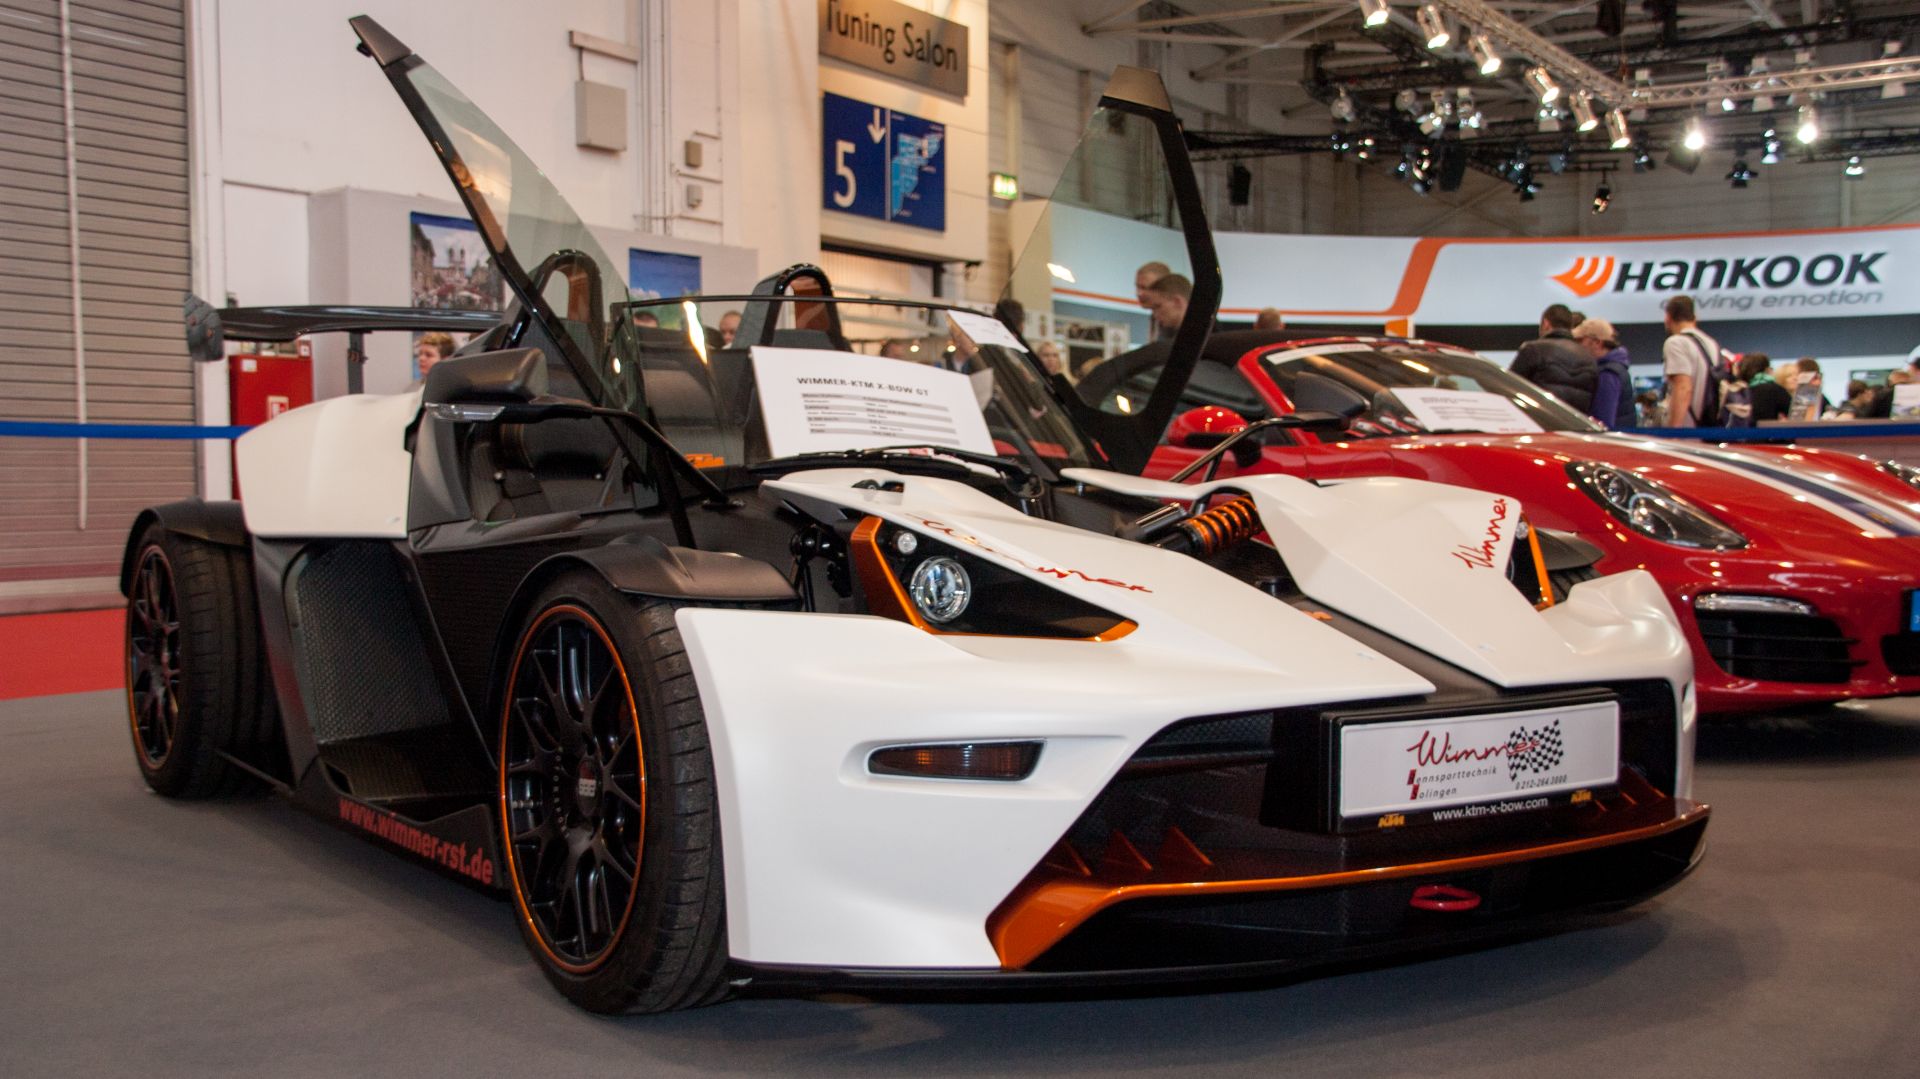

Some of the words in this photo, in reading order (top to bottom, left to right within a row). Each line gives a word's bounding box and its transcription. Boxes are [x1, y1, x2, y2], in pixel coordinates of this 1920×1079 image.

[826, 0, 897, 64] Tuning
[902, 22, 958, 72] Salon
[833, 140, 857, 208] 5
[1760, 290, 1884, 309] emotion
[1406, 730, 1540, 767] Wimmer
[1407, 764, 1497, 787] ennsporttechnik
[1410, 783, 1458, 801] olingen
[1432, 796, 1549, 822] www.ktm-x-bow.com
[338, 798, 494, 886] www.wimmer-rst.de
